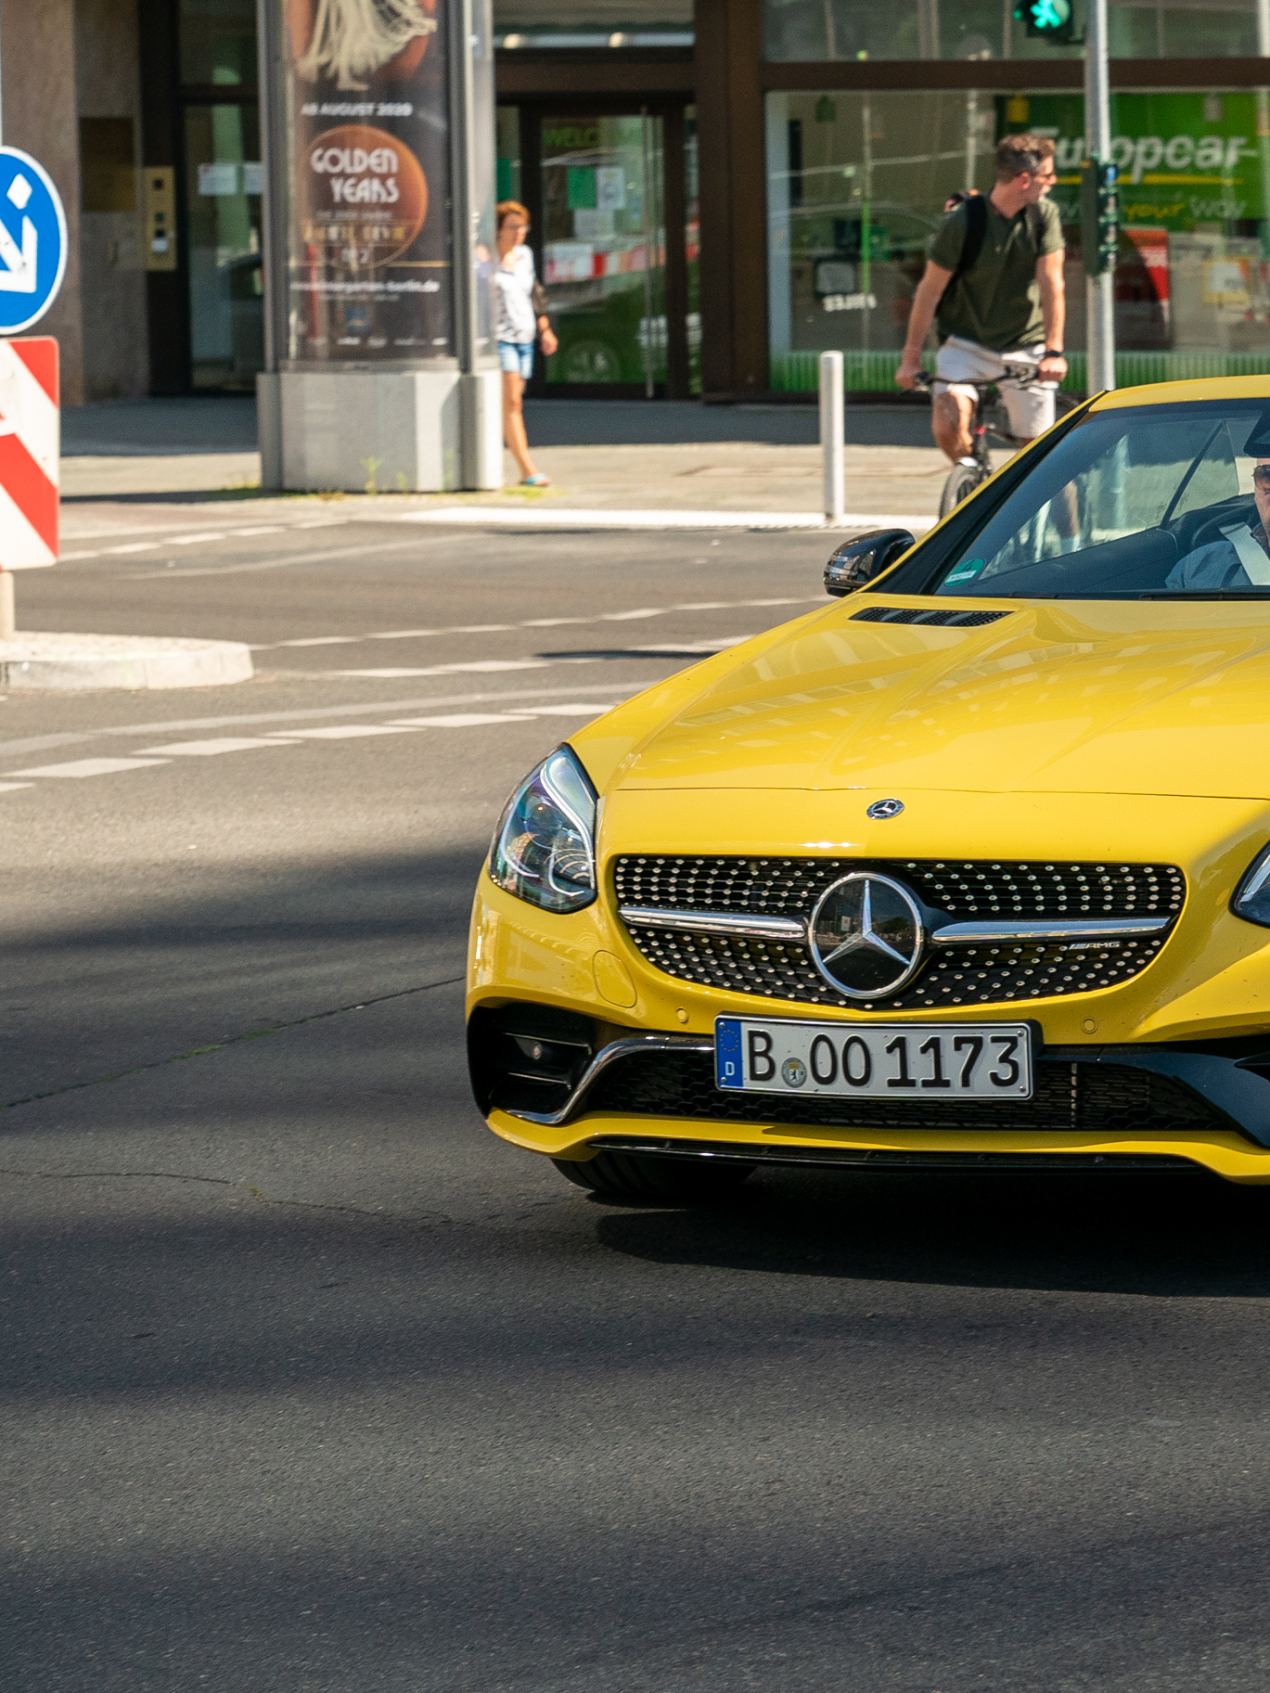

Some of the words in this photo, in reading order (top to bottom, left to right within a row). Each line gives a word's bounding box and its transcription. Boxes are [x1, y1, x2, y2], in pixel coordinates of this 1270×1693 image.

[319, 102, 375, 116] AUGUST
[309, 147, 399, 174] GOLDEN
[329, 176, 400, 204] YEARS
[724, 1060, 736, 1077] D
[747, 1029, 776, 1082] B
[885, 1034, 1020, 1088] 1173
